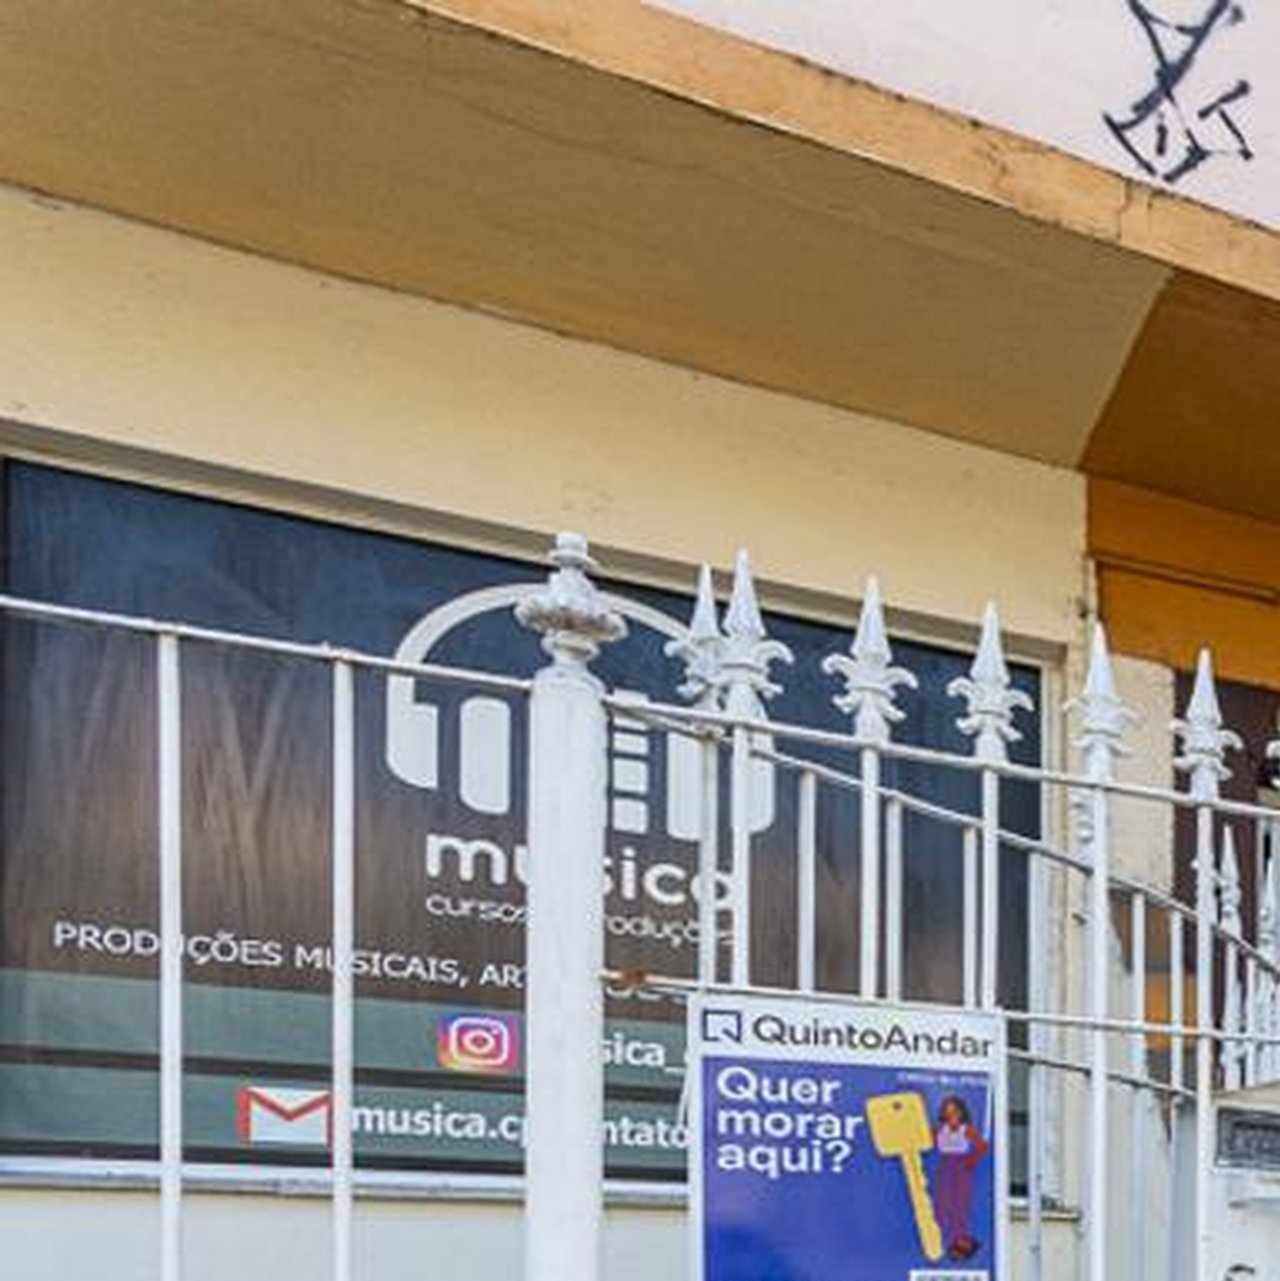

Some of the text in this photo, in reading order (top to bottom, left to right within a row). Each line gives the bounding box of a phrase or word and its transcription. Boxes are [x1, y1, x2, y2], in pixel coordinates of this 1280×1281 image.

[425, 833, 738, 908] mica
[53, 921, 283, 966] PRODÇÕES
[752, 1014, 994, 1058] QuintoAndar
[716, 1066, 842, 1104] Quer
[716, 1106, 864, 1140] morar
[716, 1141, 851, 1180] aqui?
